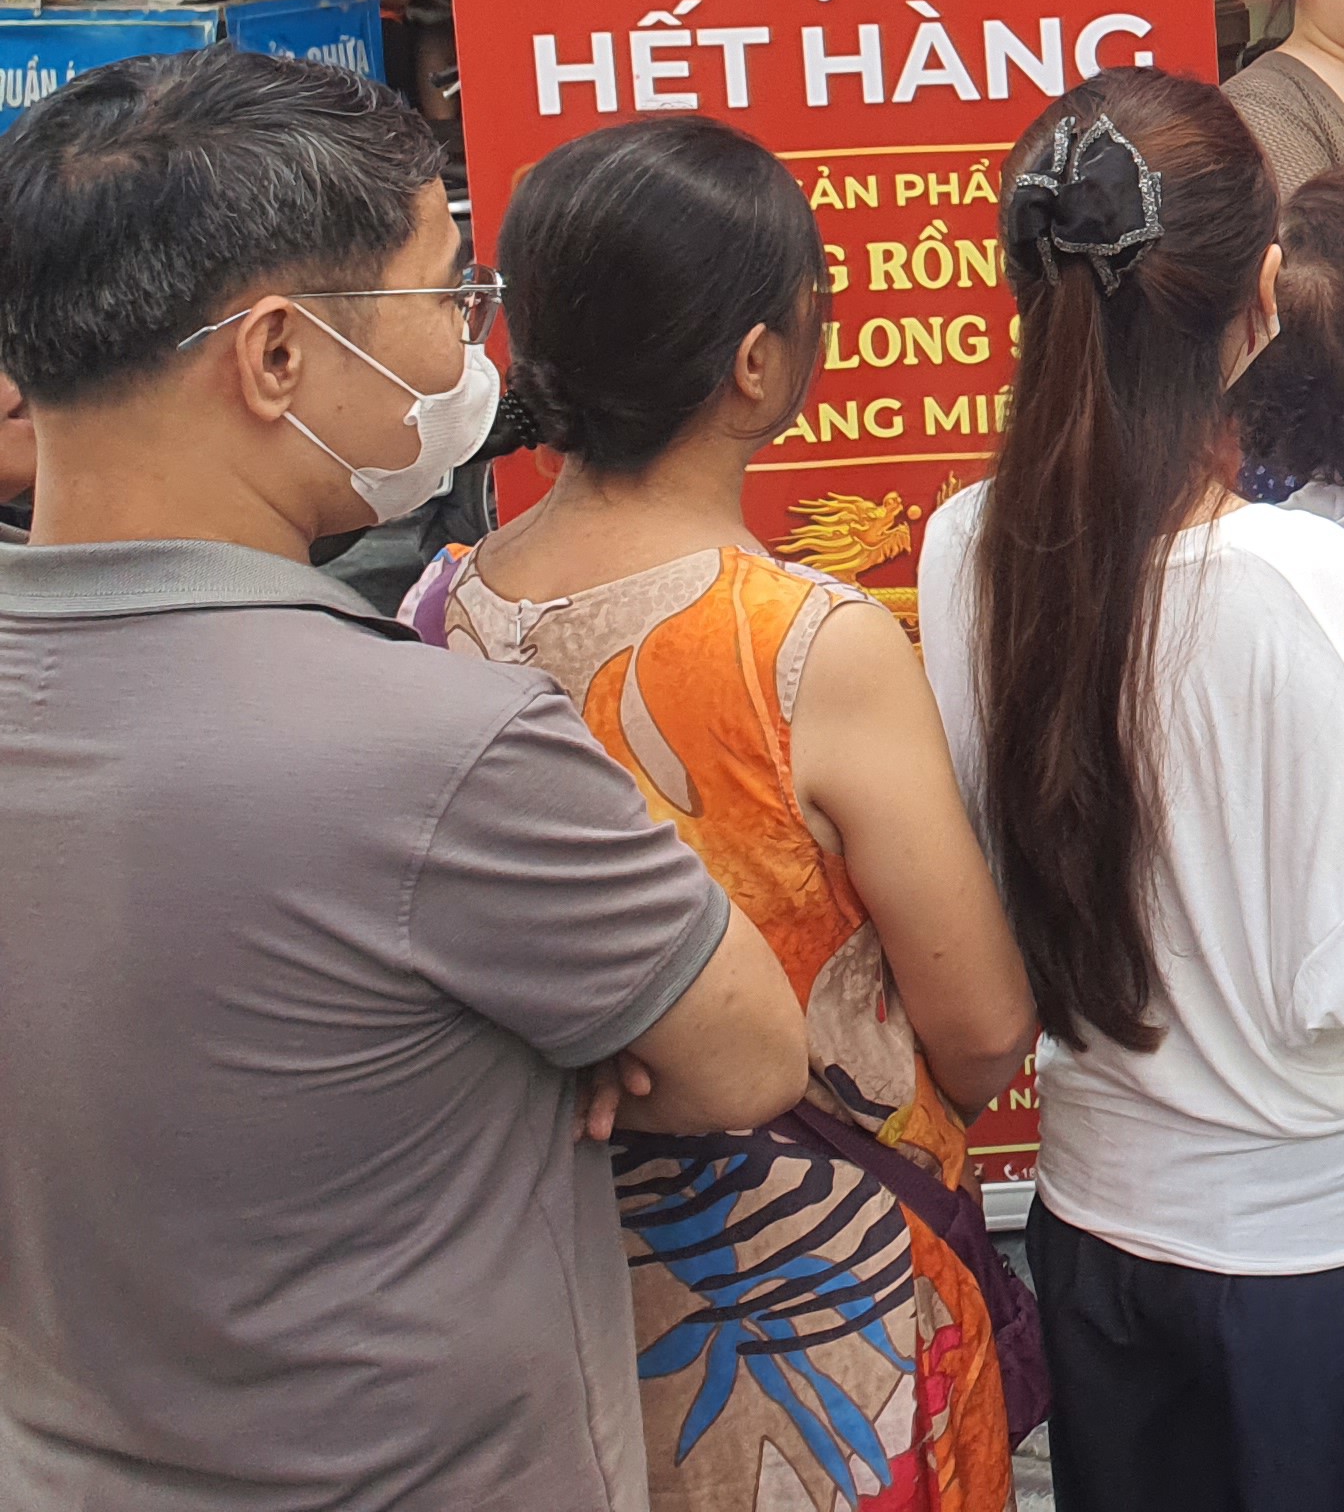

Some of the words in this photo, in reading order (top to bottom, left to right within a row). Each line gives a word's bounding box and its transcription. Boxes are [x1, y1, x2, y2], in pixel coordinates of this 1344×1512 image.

[801, 0, 1157, 107] HÀNG
[797, 166, 879, 210] ẢN
[895, 158, 1003, 207] PHẨ
[866, 219, 1006, 291] RỒN
